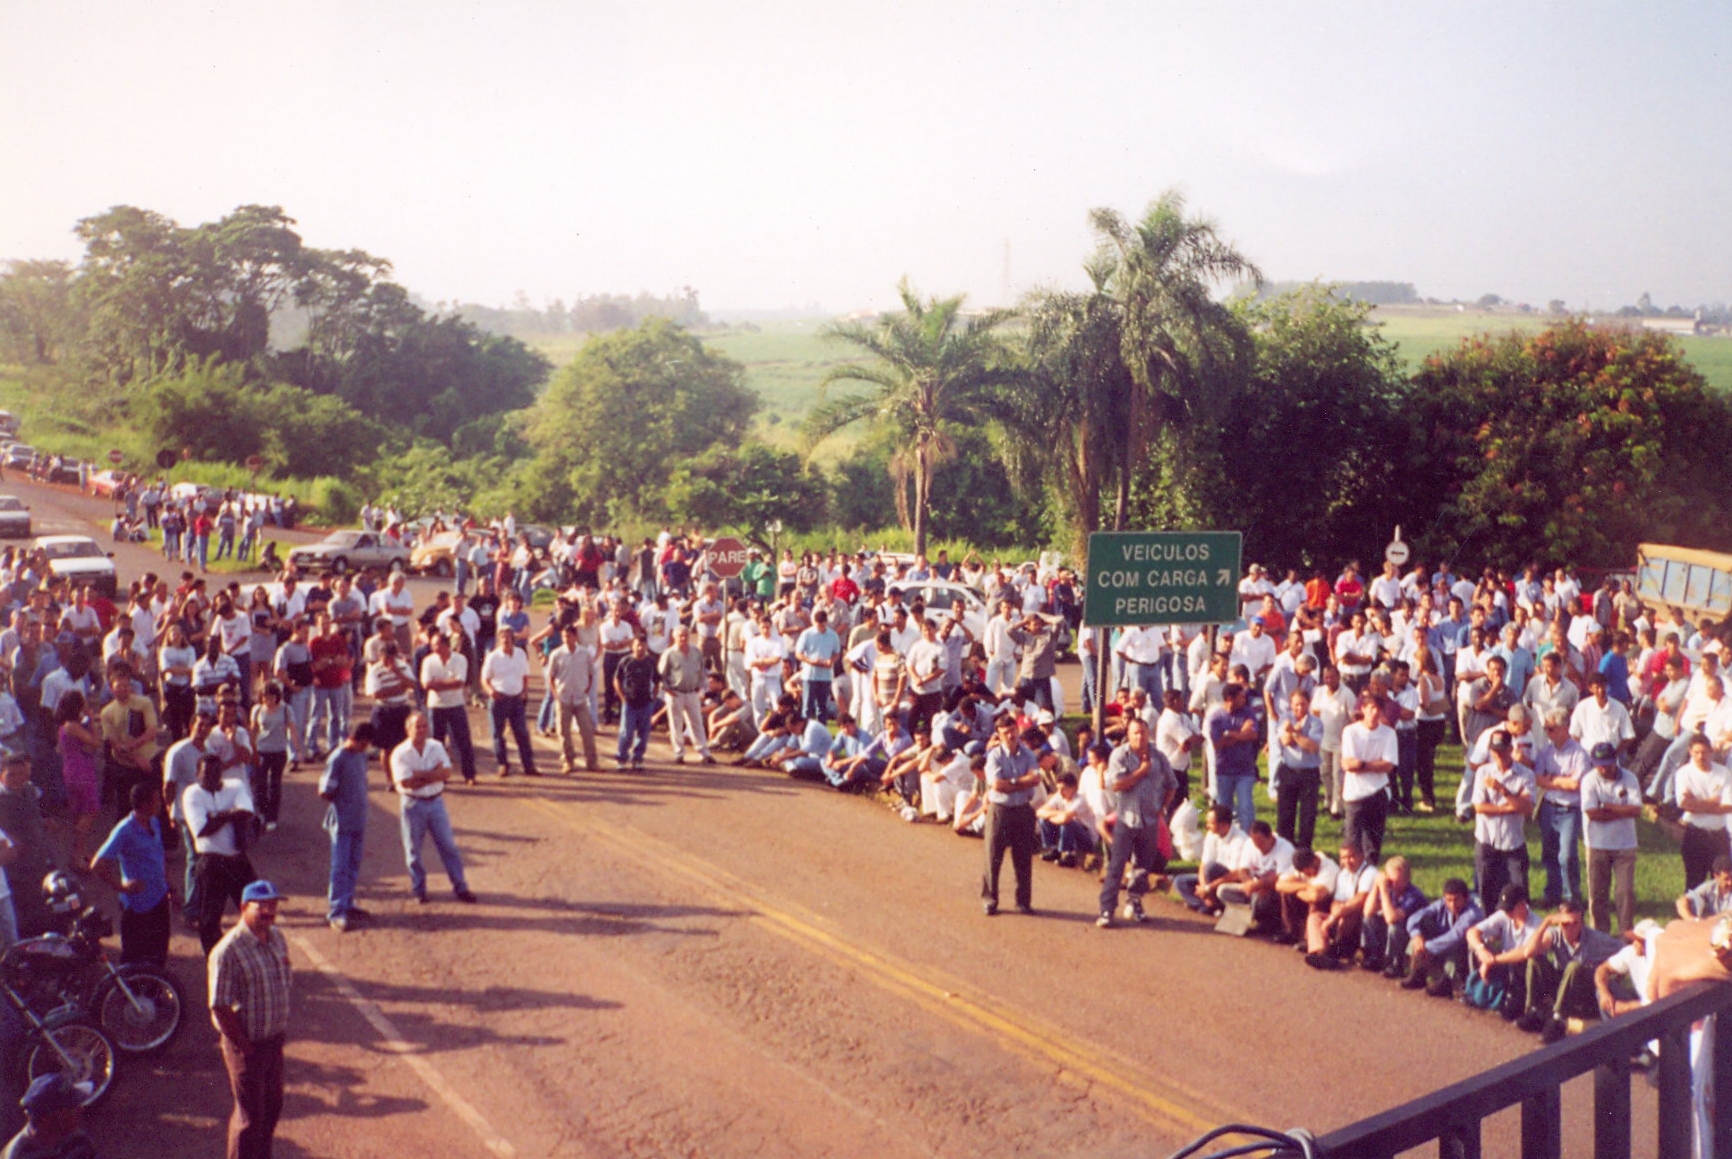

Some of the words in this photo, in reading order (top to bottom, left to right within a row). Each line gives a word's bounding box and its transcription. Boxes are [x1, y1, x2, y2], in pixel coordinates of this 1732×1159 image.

[709, 550, 746, 564] PARE
[1122, 544, 1210, 561] VEICULOS
[1098, 571, 1139, 588] COM
[1147, 570, 1208, 587] CARGA
[1115, 596, 1206, 615] PERIGOSA
